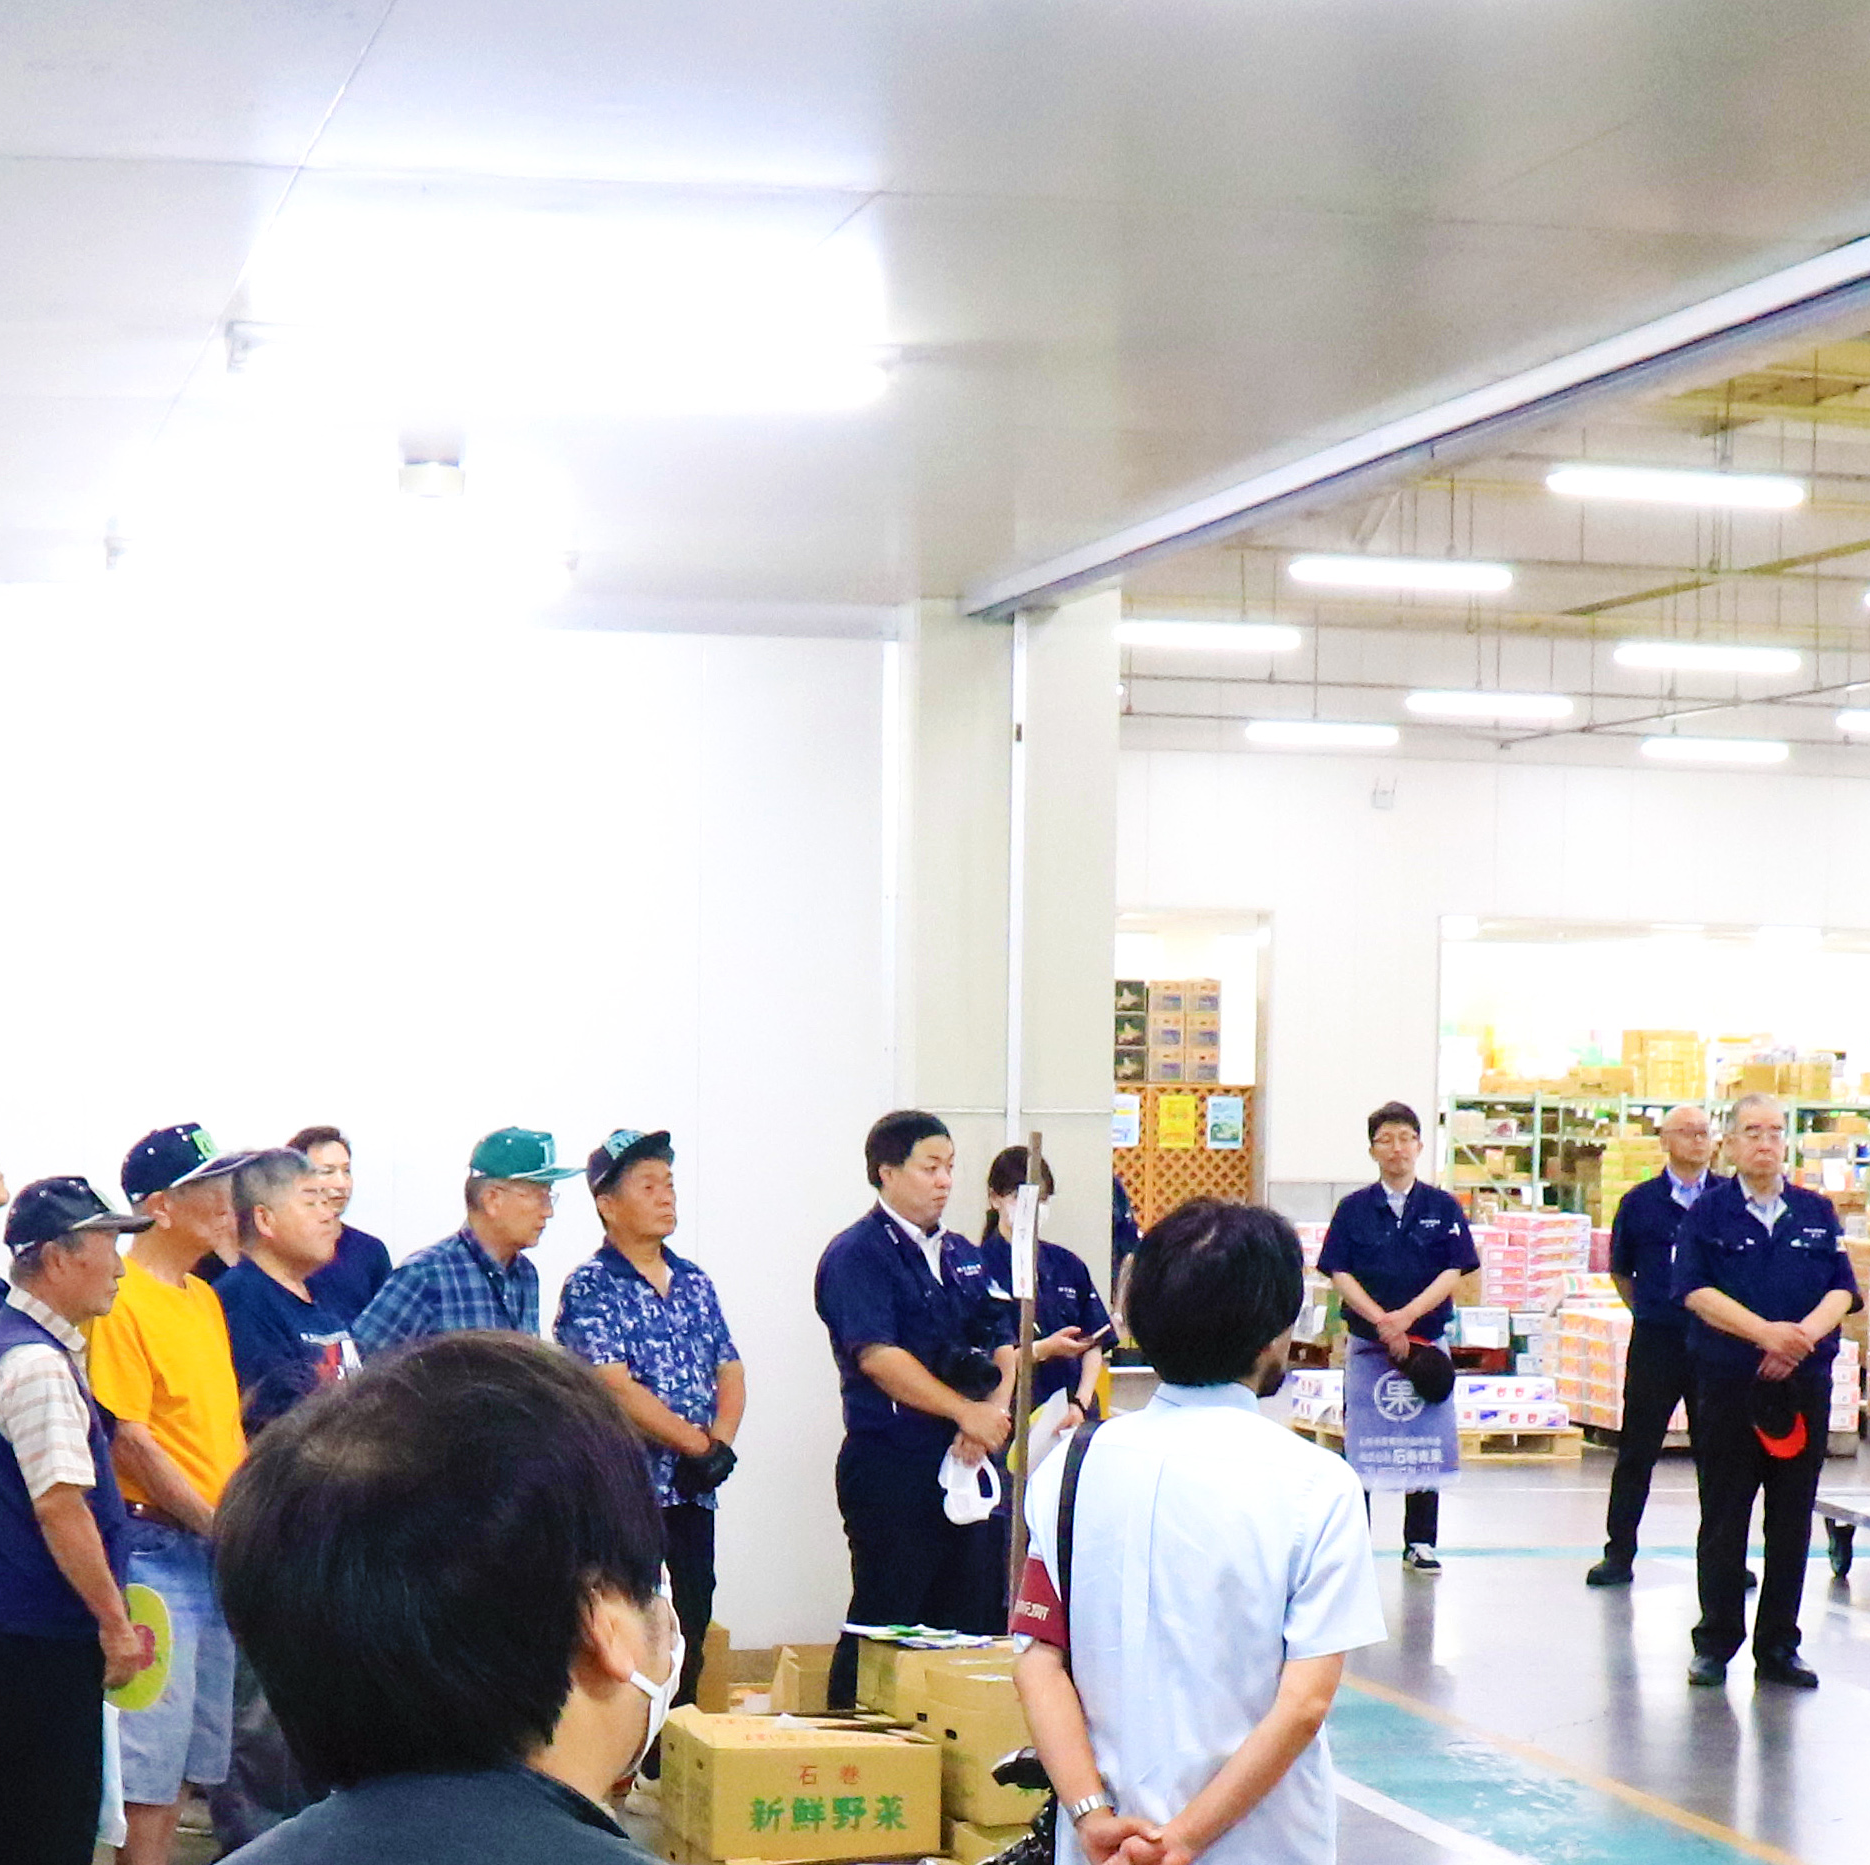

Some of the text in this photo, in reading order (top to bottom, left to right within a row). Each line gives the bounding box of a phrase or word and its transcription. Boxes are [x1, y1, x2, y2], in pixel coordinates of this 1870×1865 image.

[798, 1763, 862, 1788] 石巻
[749, 1794, 908, 1834] 新鮮野菜
